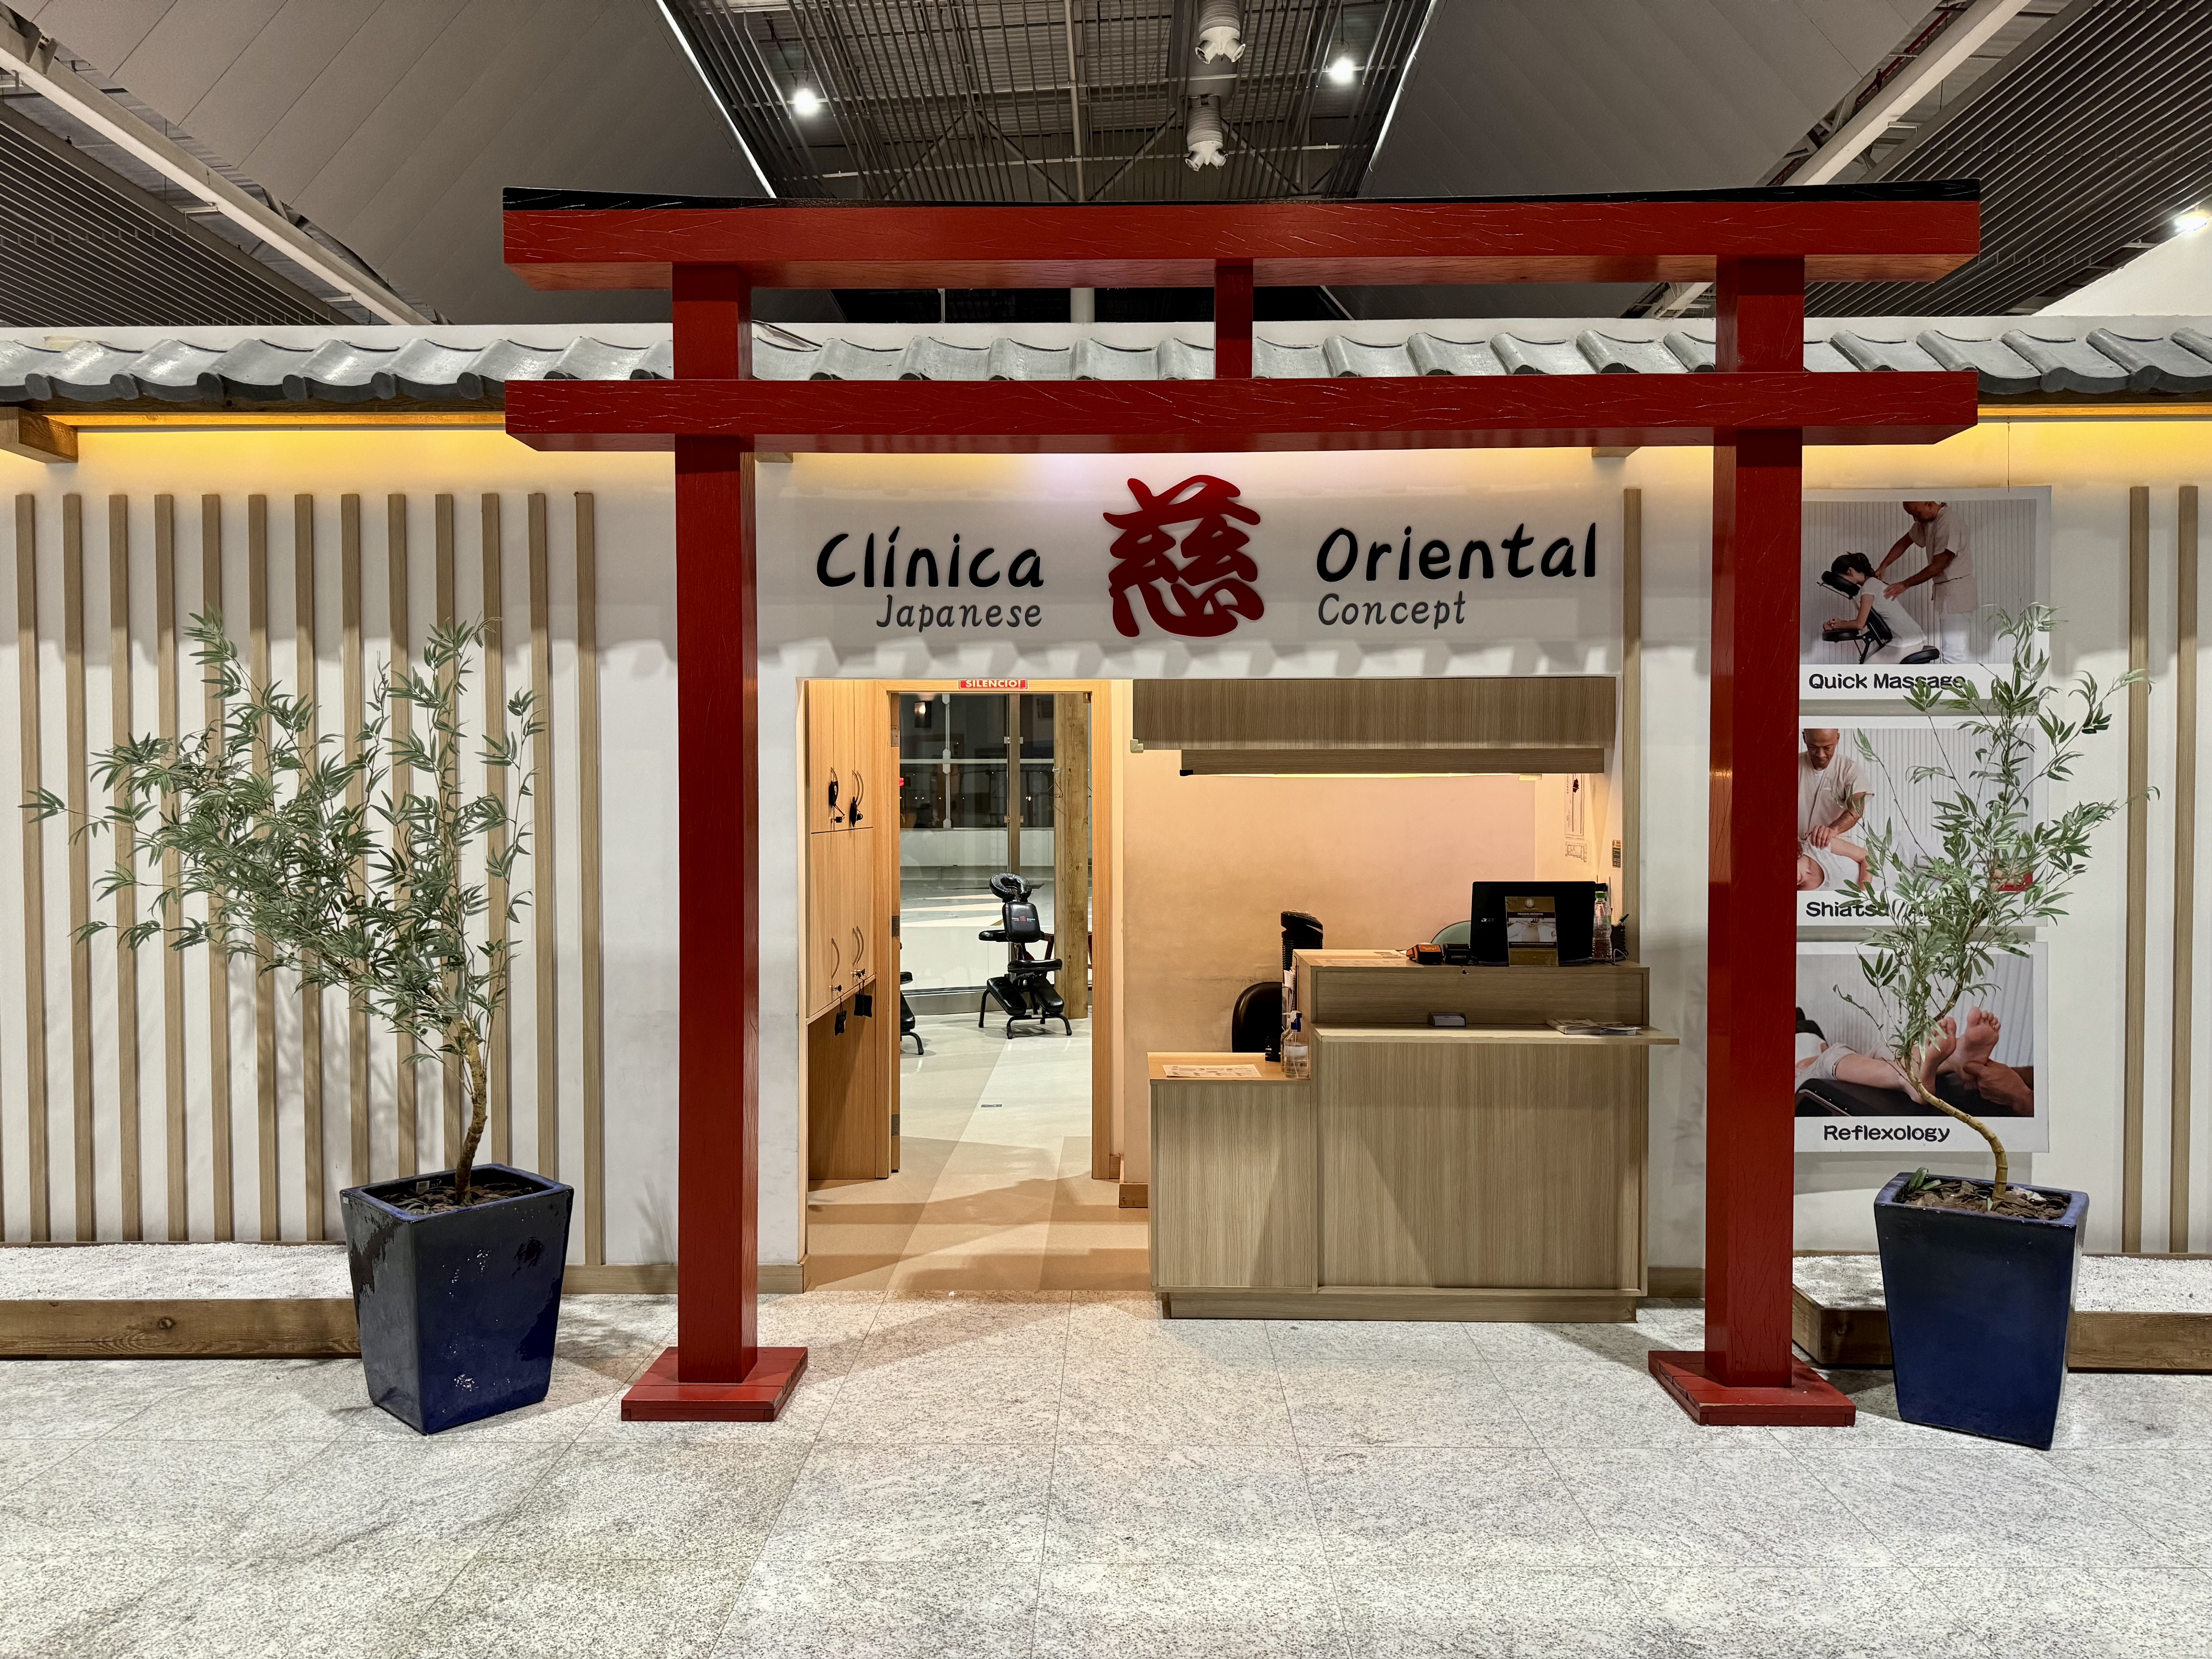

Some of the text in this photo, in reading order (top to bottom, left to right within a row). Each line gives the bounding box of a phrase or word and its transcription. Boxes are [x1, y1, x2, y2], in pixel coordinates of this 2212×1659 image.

[816, 526, 1044, 588] Clínica
[1316, 522, 1597, 582] Oriental
[876, 594, 1042, 633] Japanese
[1318, 590, 1466, 630] Concept
[1809, 673, 1868, 689] Quick
[1824, 1125, 1950, 1142] Reflexology
